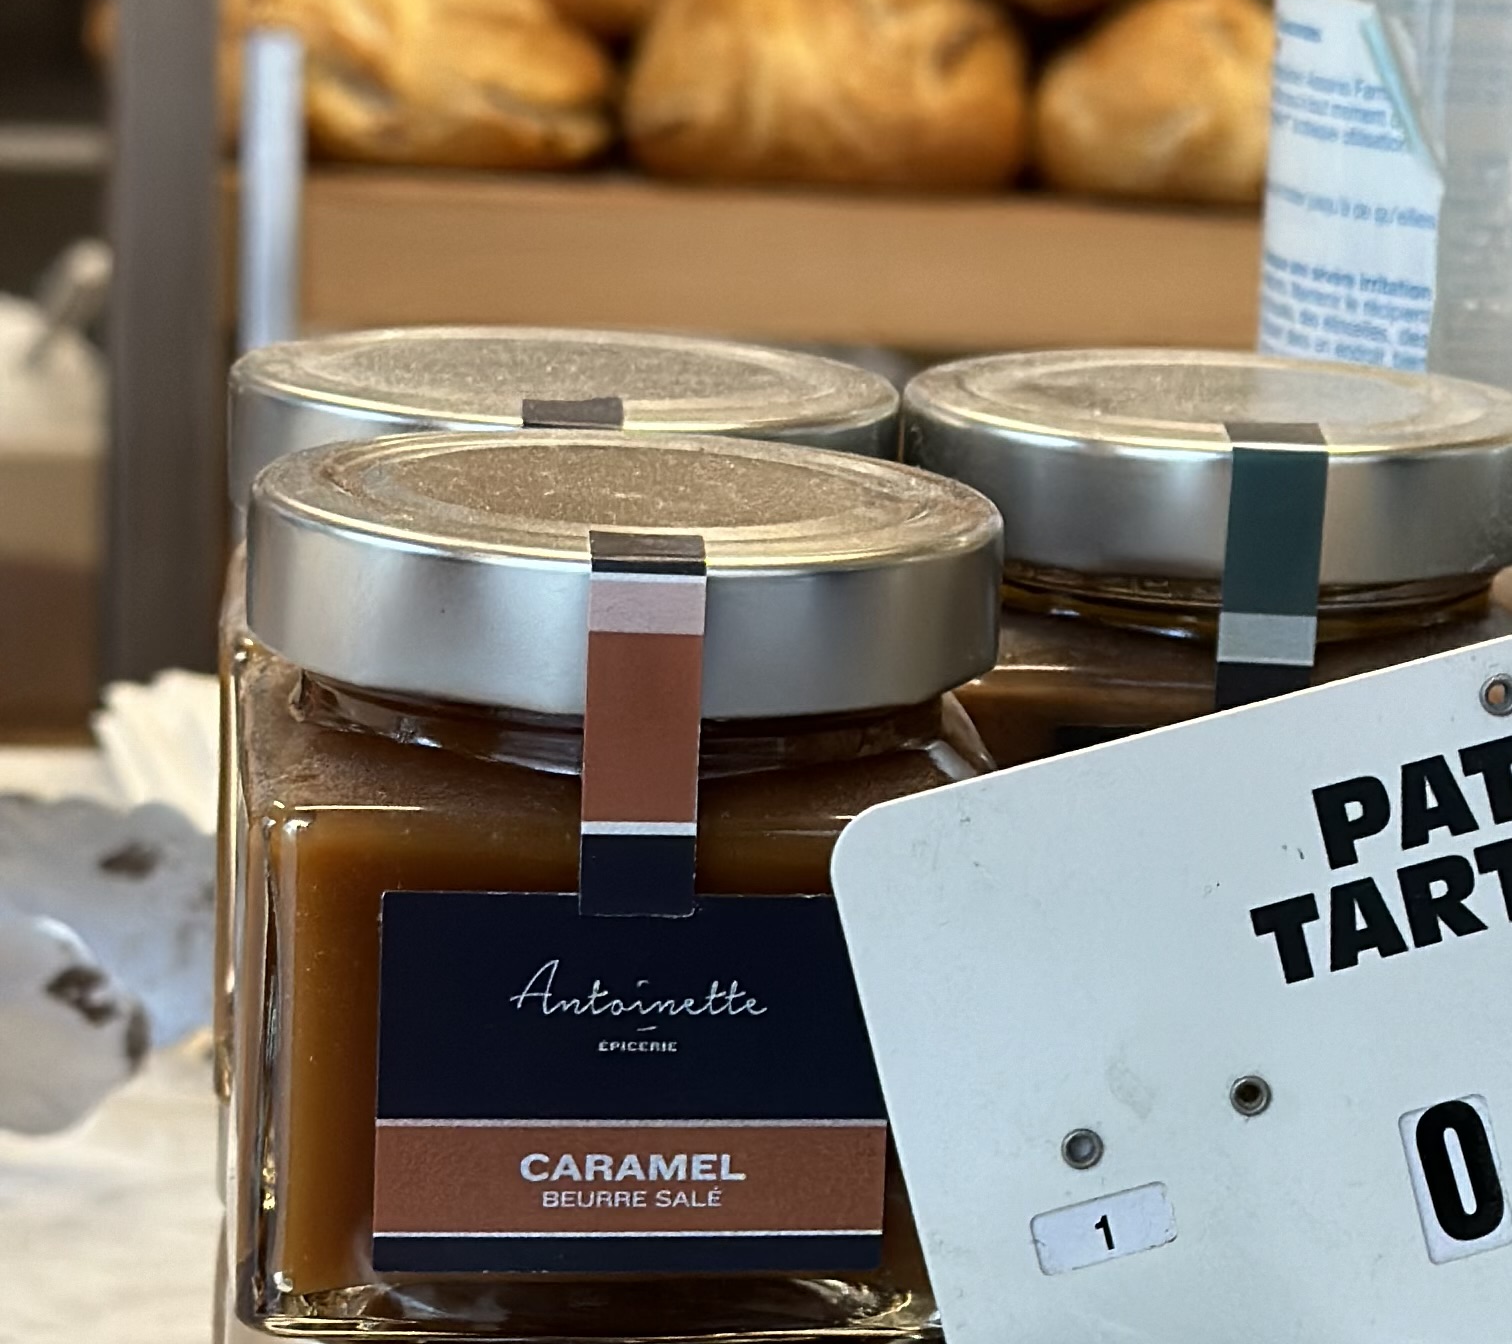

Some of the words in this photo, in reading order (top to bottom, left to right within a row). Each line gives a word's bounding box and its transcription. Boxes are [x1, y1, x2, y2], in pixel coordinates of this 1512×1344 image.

[510, 958, 768, 1016] Antoinette
[519, 1152, 746, 1182] CARAMEL
[542, 1189, 647, 1208] BEURRE
[655, 1186, 722, 1208] SALÉ
[1094, 1213, 1115, 1251] 1
